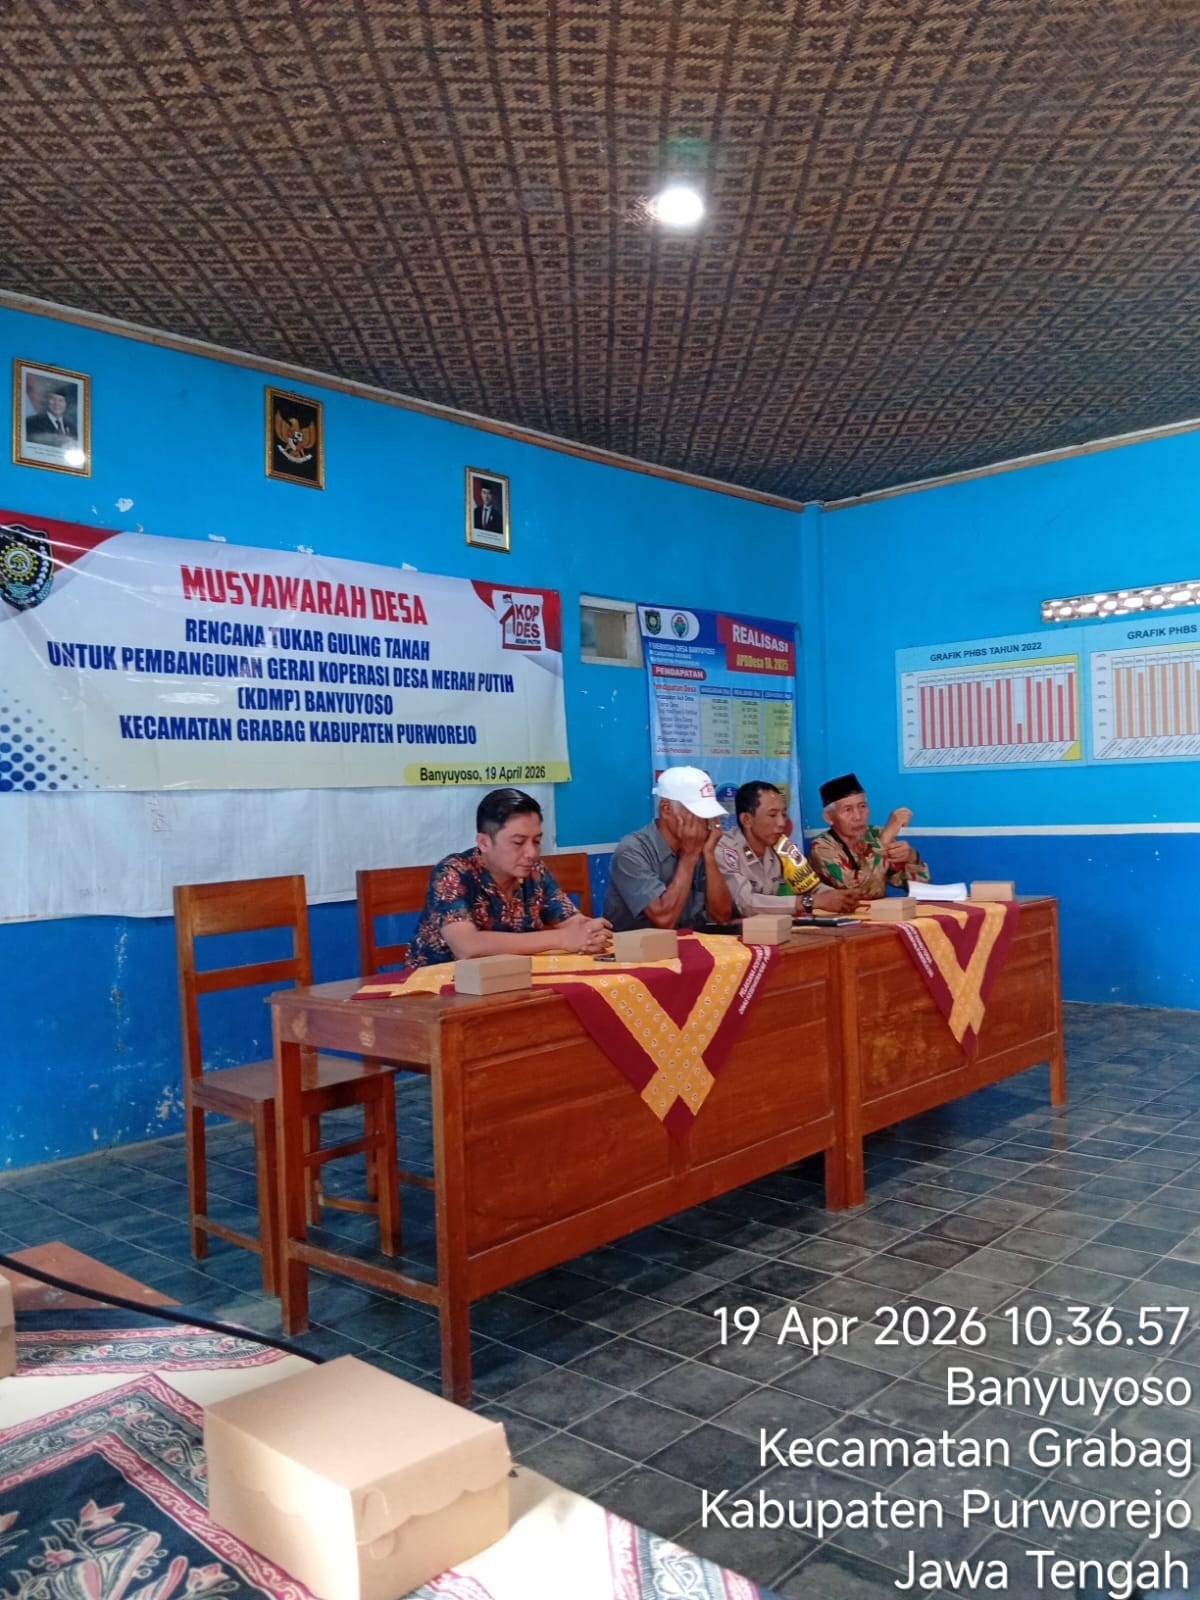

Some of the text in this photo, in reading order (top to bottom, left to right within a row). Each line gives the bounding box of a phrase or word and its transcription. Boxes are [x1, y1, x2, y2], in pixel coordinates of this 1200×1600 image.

[180, 564, 428, 625] MUSYAWARAH DESA
[514, 603, 540, 622] KOP
[185, 618, 430, 661] RENCANA TUKAR GULING TANAH
[516, 621, 541, 638] DES
[732, 623, 789, 653] REALISASI
[1127, 624, 1198, 640] GRAFIK PHBS
[930, 641, 1042, 662] GRAFIK PHBS TAHUN 2022
[47, 641, 515, 693] UNTUK PEMBANGUNAN GERAI KOPERASI DESA MERAH PUTIH
[654, 666, 704, 680] PENDAPATAN
[304, 690, 393, 715] BANYUYOSO
[119, 714, 477, 745] KECAMATAN GRABAG KABUPATEN PURWOREJO
[420, 765, 546, 784] Banyuyoso, 19 April 2026
